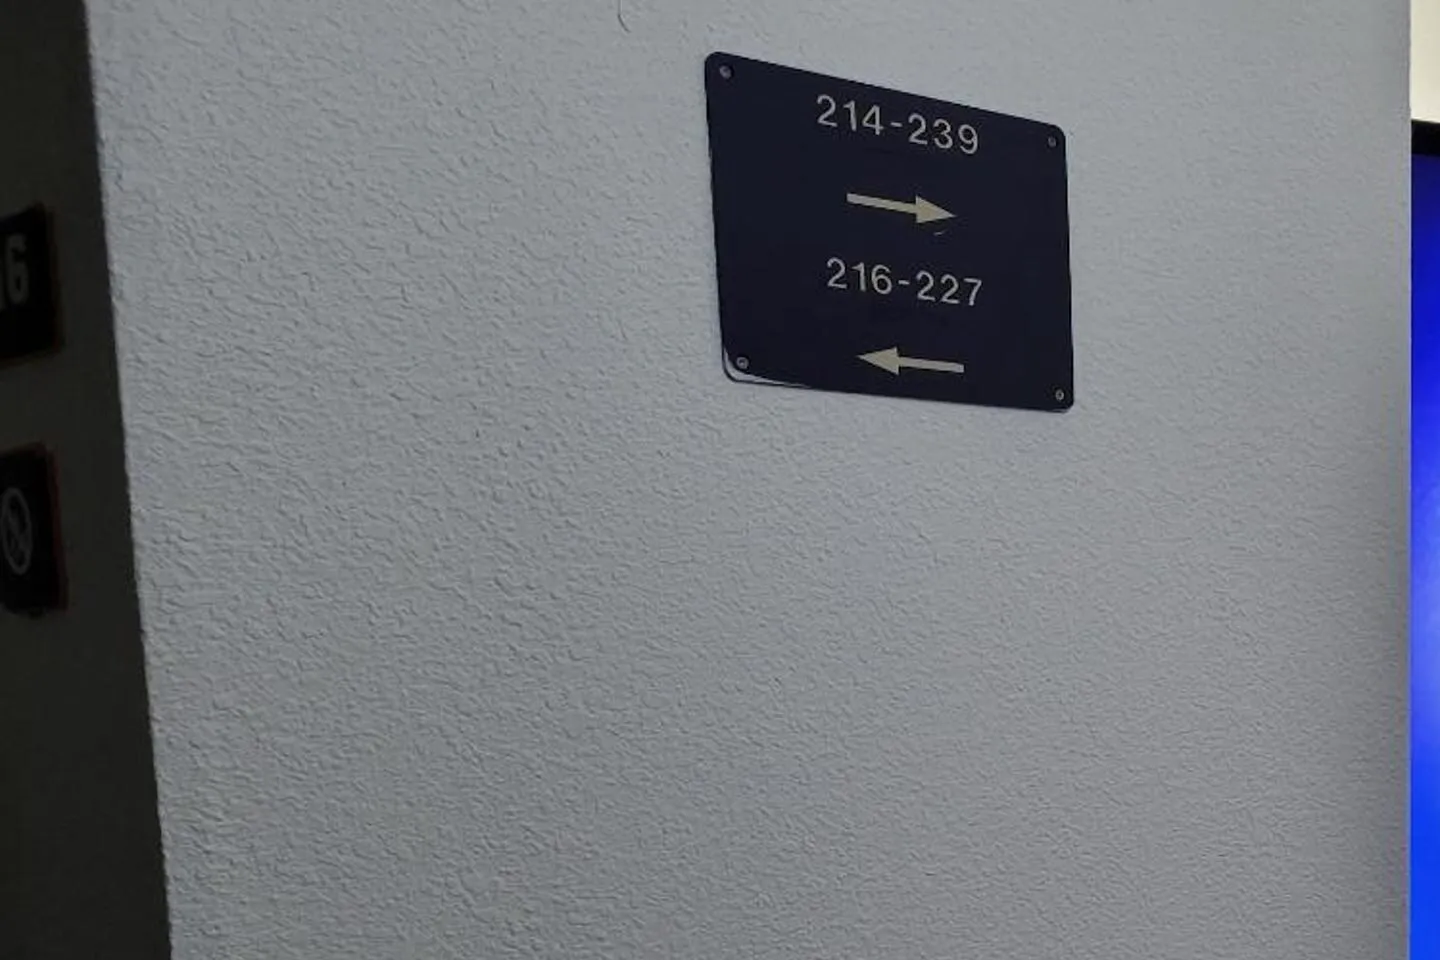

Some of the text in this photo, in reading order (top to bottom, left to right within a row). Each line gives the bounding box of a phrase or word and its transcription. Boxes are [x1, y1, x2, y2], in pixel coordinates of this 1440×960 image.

[816, 94, 979, 155] 214-239
[0, 232, 29, 309] 6
[826, 257, 983, 306] 216-227
